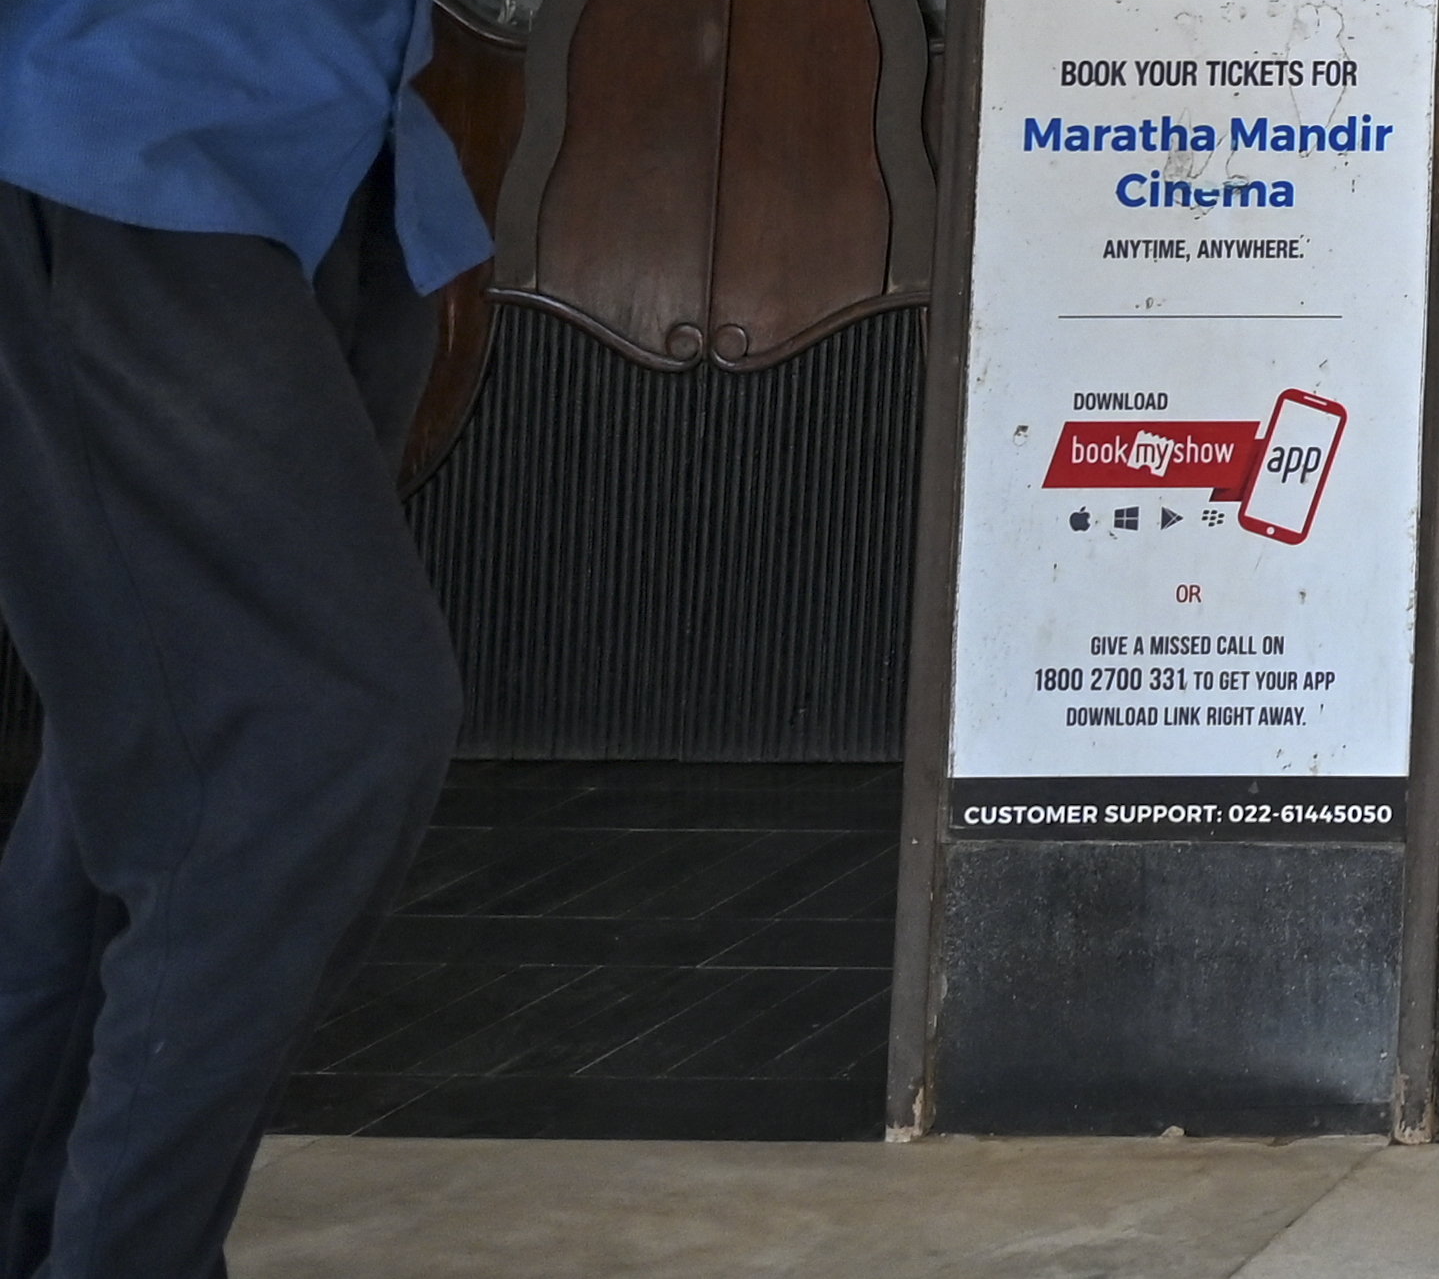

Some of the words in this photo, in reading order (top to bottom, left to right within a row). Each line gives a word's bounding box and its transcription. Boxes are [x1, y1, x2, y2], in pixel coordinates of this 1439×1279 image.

[1061, 61, 1127, 86] BOOK
[1135, 61, 1198, 86] YOUR
[1206, 61, 1303, 86] TICKETS
[1312, 61, 1357, 86] FOR
[1023, 117, 1215, 152] Maratha
[1230, 115, 1393, 152] Mandir
[1116, 171, 1294, 208] Cinema
[1103, 240, 1190, 262] ANYTIME,
[1197, 240, 1304, 259] ANYWHERE.
[1073, 393, 1168, 410] DOWNLOAD
[1071, 430, 1234, 477] bookmyshow
[1266, 446, 1322, 484] app
[1175, 584, 1201, 603] OR
[1090, 636, 1128, 656] GIVE
[1133, 636, 1144, 655] A
[1150, 636, 1212, 656] MISSED
[1217, 636, 1257, 656] CALL
[1262, 636, 1284, 656] ON
[1035, 668, 1083, 692] 1800
[1090, 668, 1142, 692] 2700
[1149, 668, 1187, 692] 331
[1193, 671, 1213, 691] TO
[1219, 671, 1250, 691] GET
[1255, 671, 1298, 691] YOUR
[1303, 671, 1336, 691] APP
[1066, 707, 1158, 726] DOWNLOAD
[1164, 707, 1200, 726] LINK
[1207, 707, 1254, 726] RIGHT
[1258, 707, 1307, 726] AWAY.
[964, 806, 1098, 825] CUSTOMER
[1104, 805, 1223, 824] SUPPORT:
[1228, 805, 1392, 824] 022-61445050
